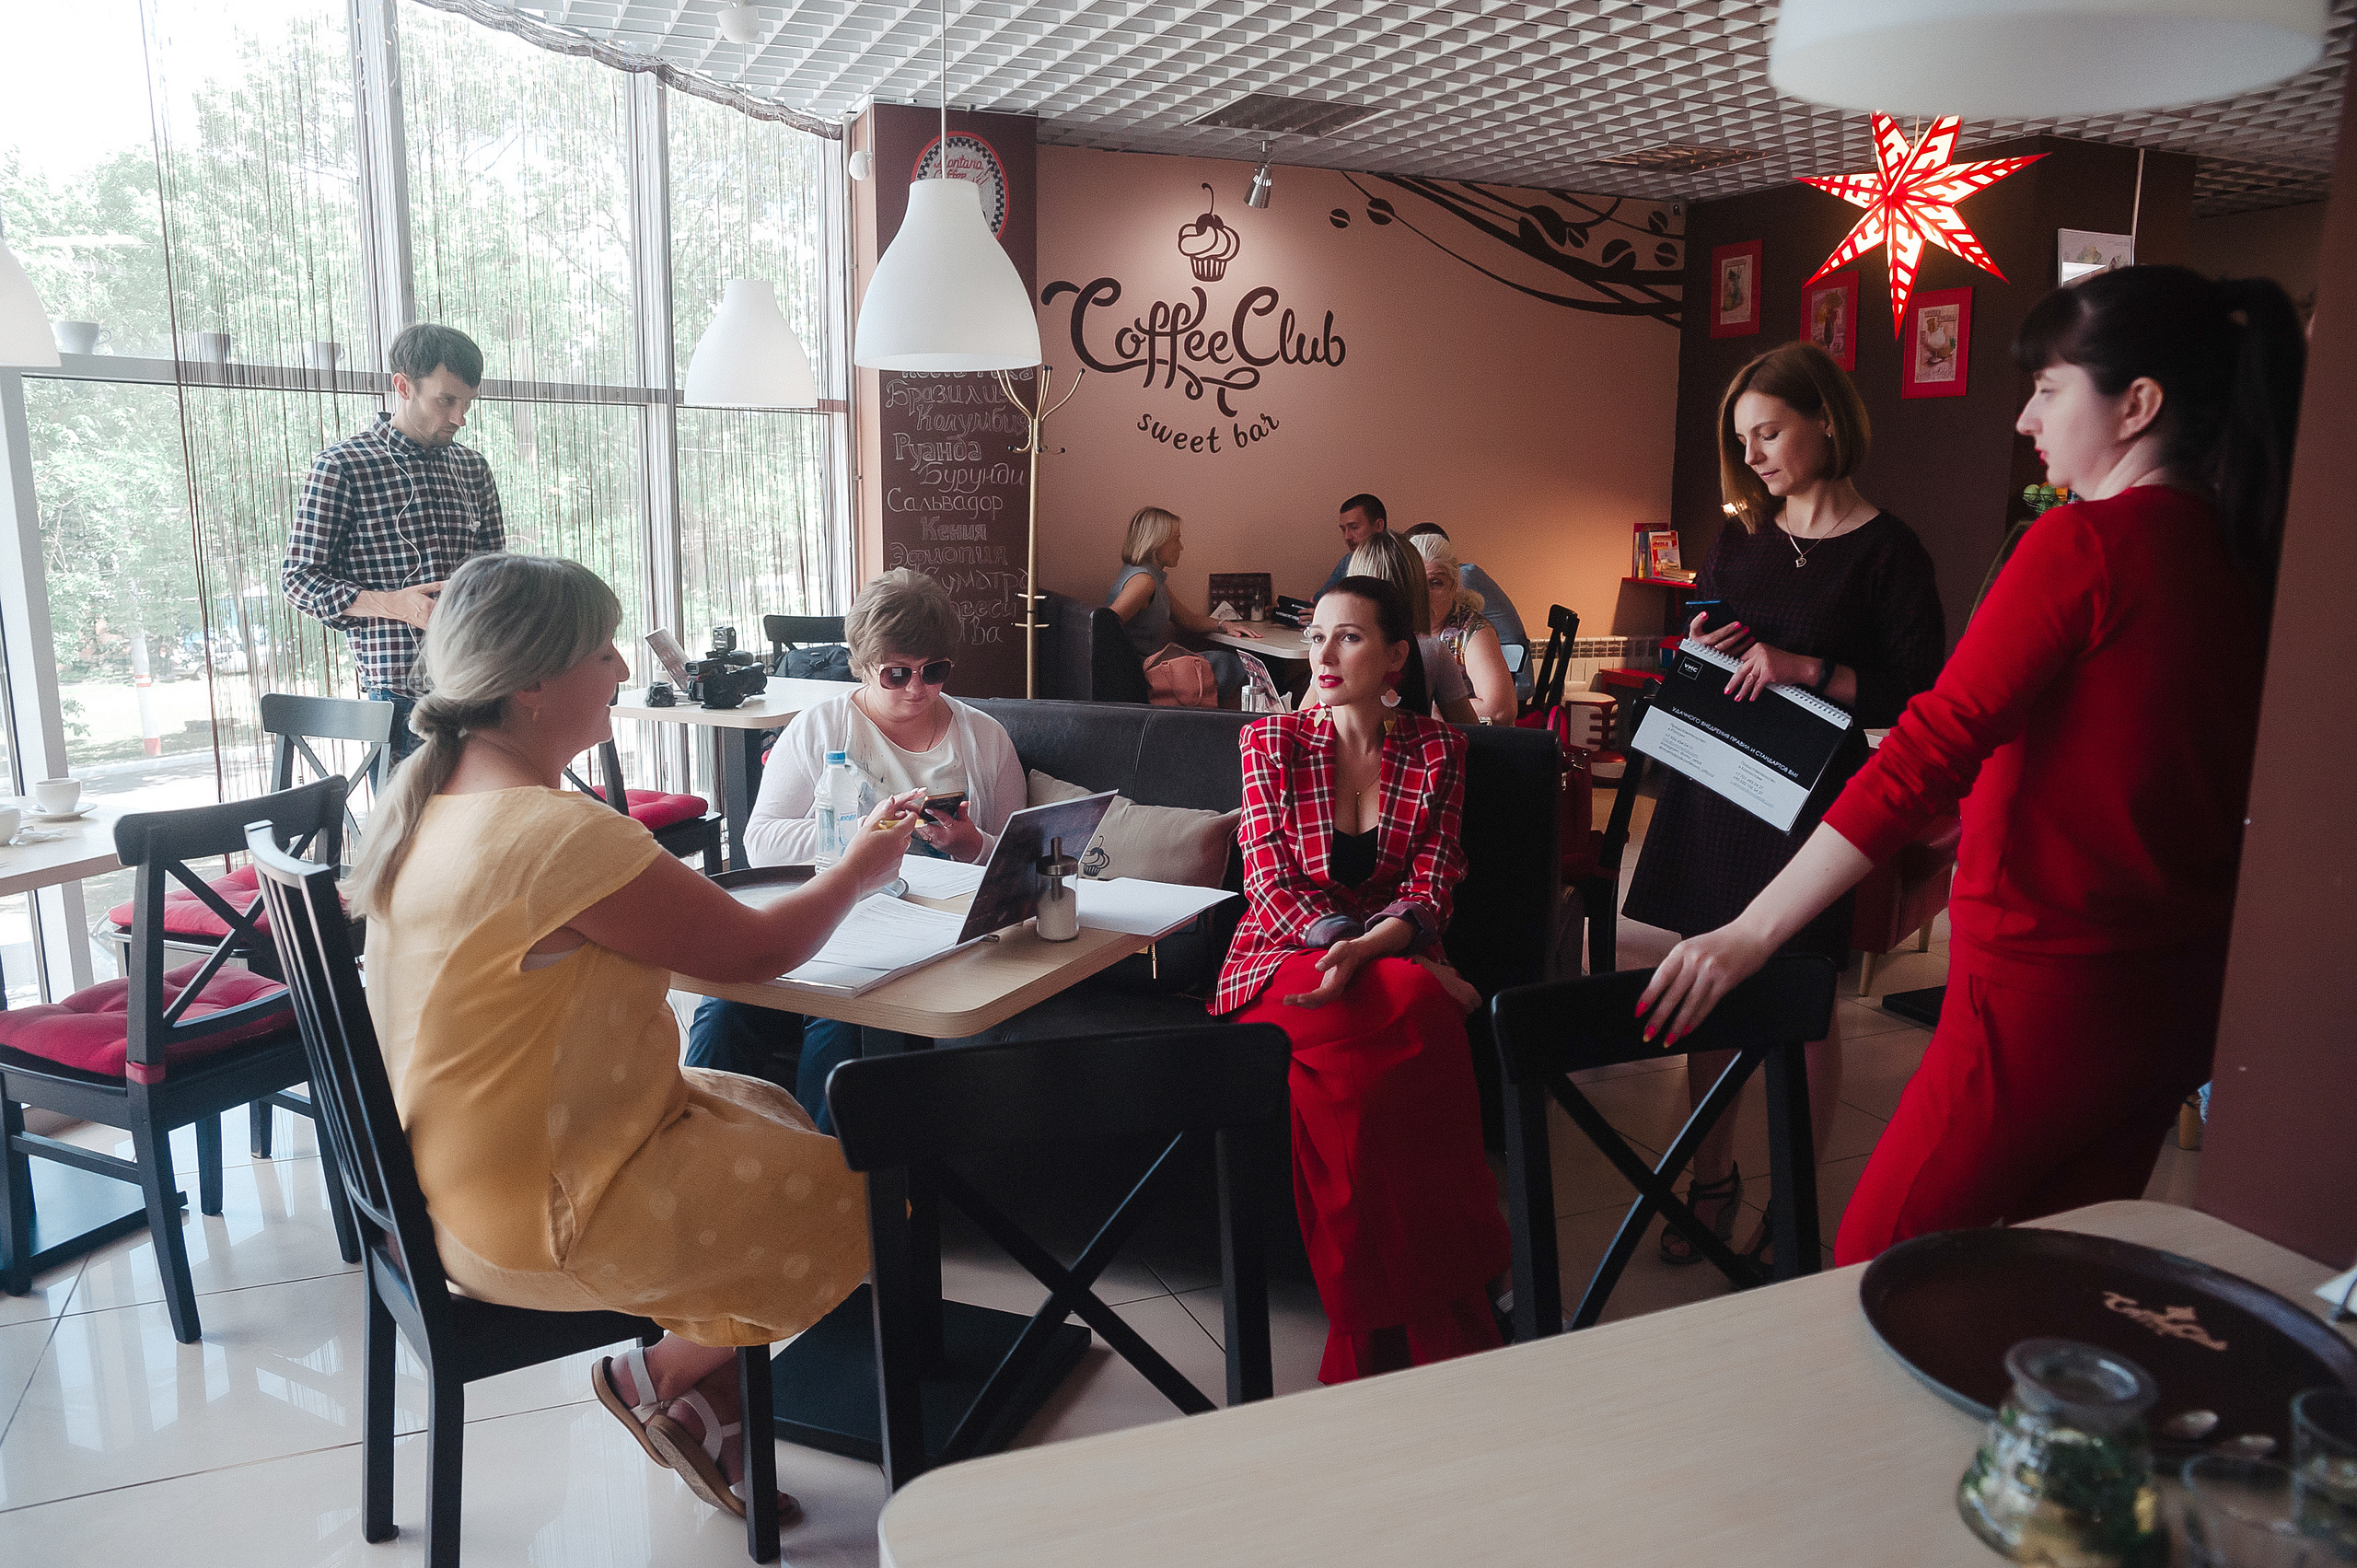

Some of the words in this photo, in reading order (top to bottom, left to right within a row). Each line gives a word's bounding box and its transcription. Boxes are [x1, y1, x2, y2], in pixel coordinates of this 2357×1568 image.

[933, 169, 967, 180] Cffee
[1041, 276, 1236, 400] Coffee
[1232, 285, 1346, 367] Club
[916, 404, 1030, 439] Колумбия
[1137, 412, 1222, 454] sweet
[1233, 412, 1280, 448] bar
[892, 432, 982, 471] Руанда
[918, 461, 1026, 494] Бурунди
[887, 487, 1004, 520] Сальвадор
[921, 516, 988, 541] Кения
